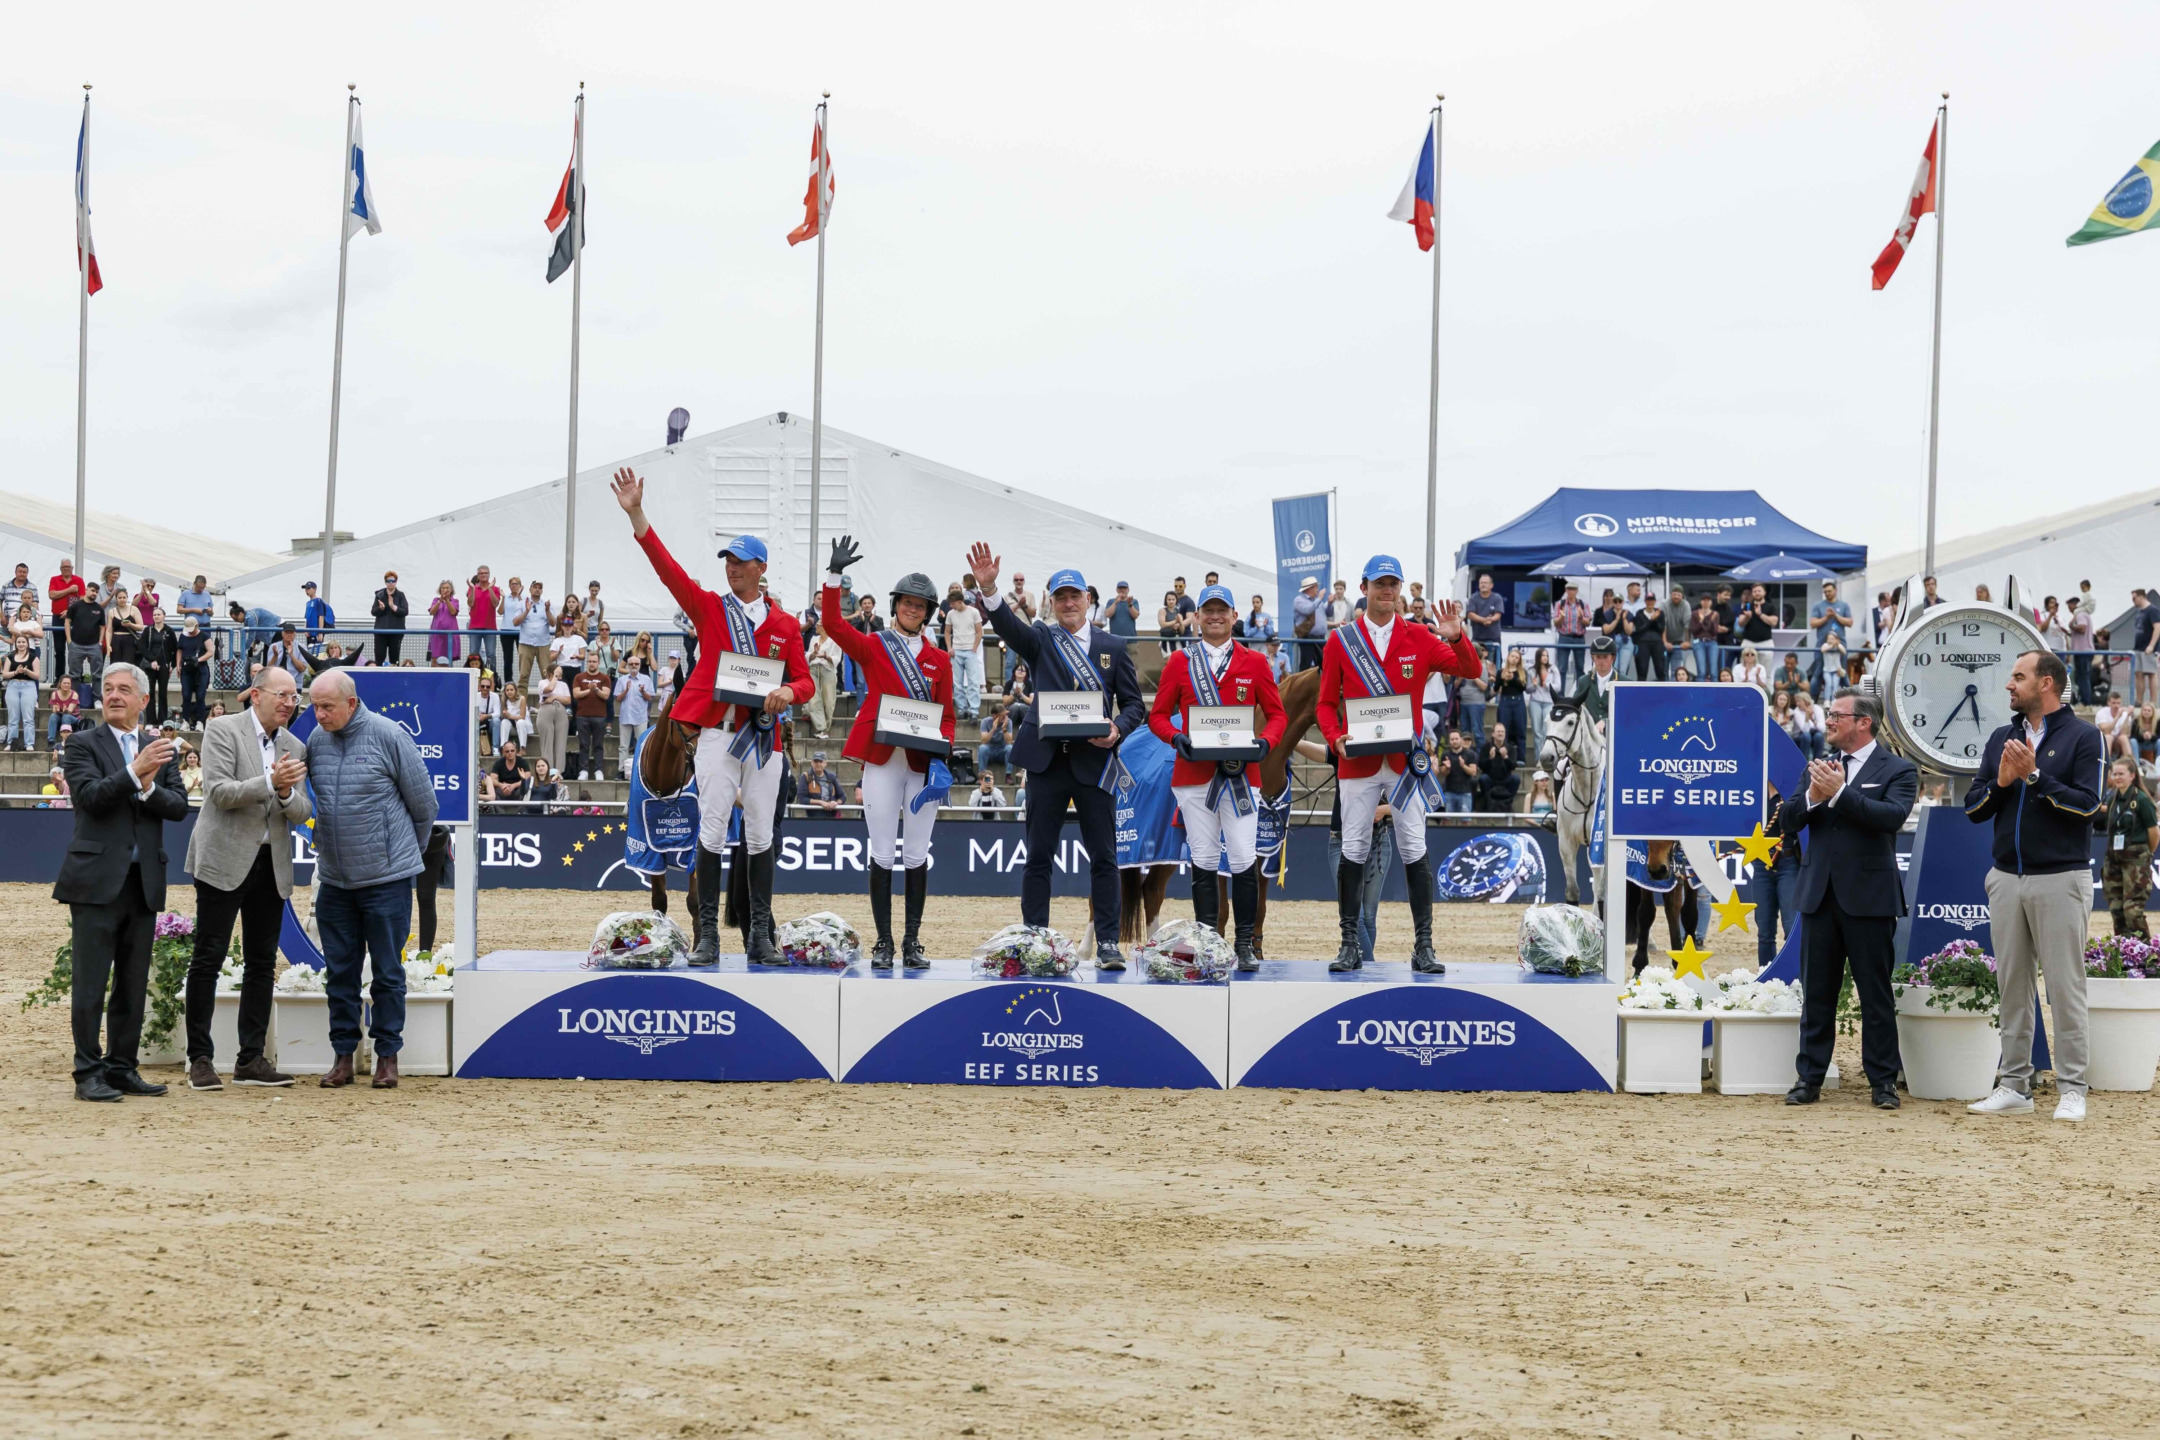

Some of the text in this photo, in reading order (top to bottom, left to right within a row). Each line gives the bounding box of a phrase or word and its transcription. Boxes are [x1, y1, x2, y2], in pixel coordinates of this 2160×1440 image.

[1627, 516, 1757, 528] NÜRNBERGER
[1628, 526, 1721, 534] VERSICHERUNG
[1962, 624, 1980, 636] 12
[1935, 632, 1946, 644] 11
[2000, 632, 2005, 644] 1
[1062, 640, 1084, 668] LONGINES
[1080, 666, 1090, 680] EEF
[1914, 652, 1931, 666] 10
[1941, 653, 2001, 662] LONGINES
[730, 664, 770, 677] LONGINES
[896, 650, 921, 692] LONGINES EEF
[1358, 654, 1386, 695] LONGINES EEF
[1200, 678, 1209, 692] EEF
[1904, 684, 1917, 697] 9
[1050, 703, 1090, 711] LONGINES
[1360, 706, 1400, 716] LONGINES
[890, 708, 928, 721] LONGINES
[1912, 714, 1926, 727] 8
[1934, 736, 1948, 749] 7
[1964, 744, 1977, 757] 6
[1639, 759, 1737, 773] LONGINES
[1622, 789, 1755, 806] EEF SERIES
[1918, 904, 1991, 919] LONGIN
[558, 1008, 736, 1035] LONGINES
[1337, 1020, 1516, 1046] LONGINES
[982, 1032, 1083, 1049] LONGINES
[965, 1063, 1099, 1082] EEF SERIES
